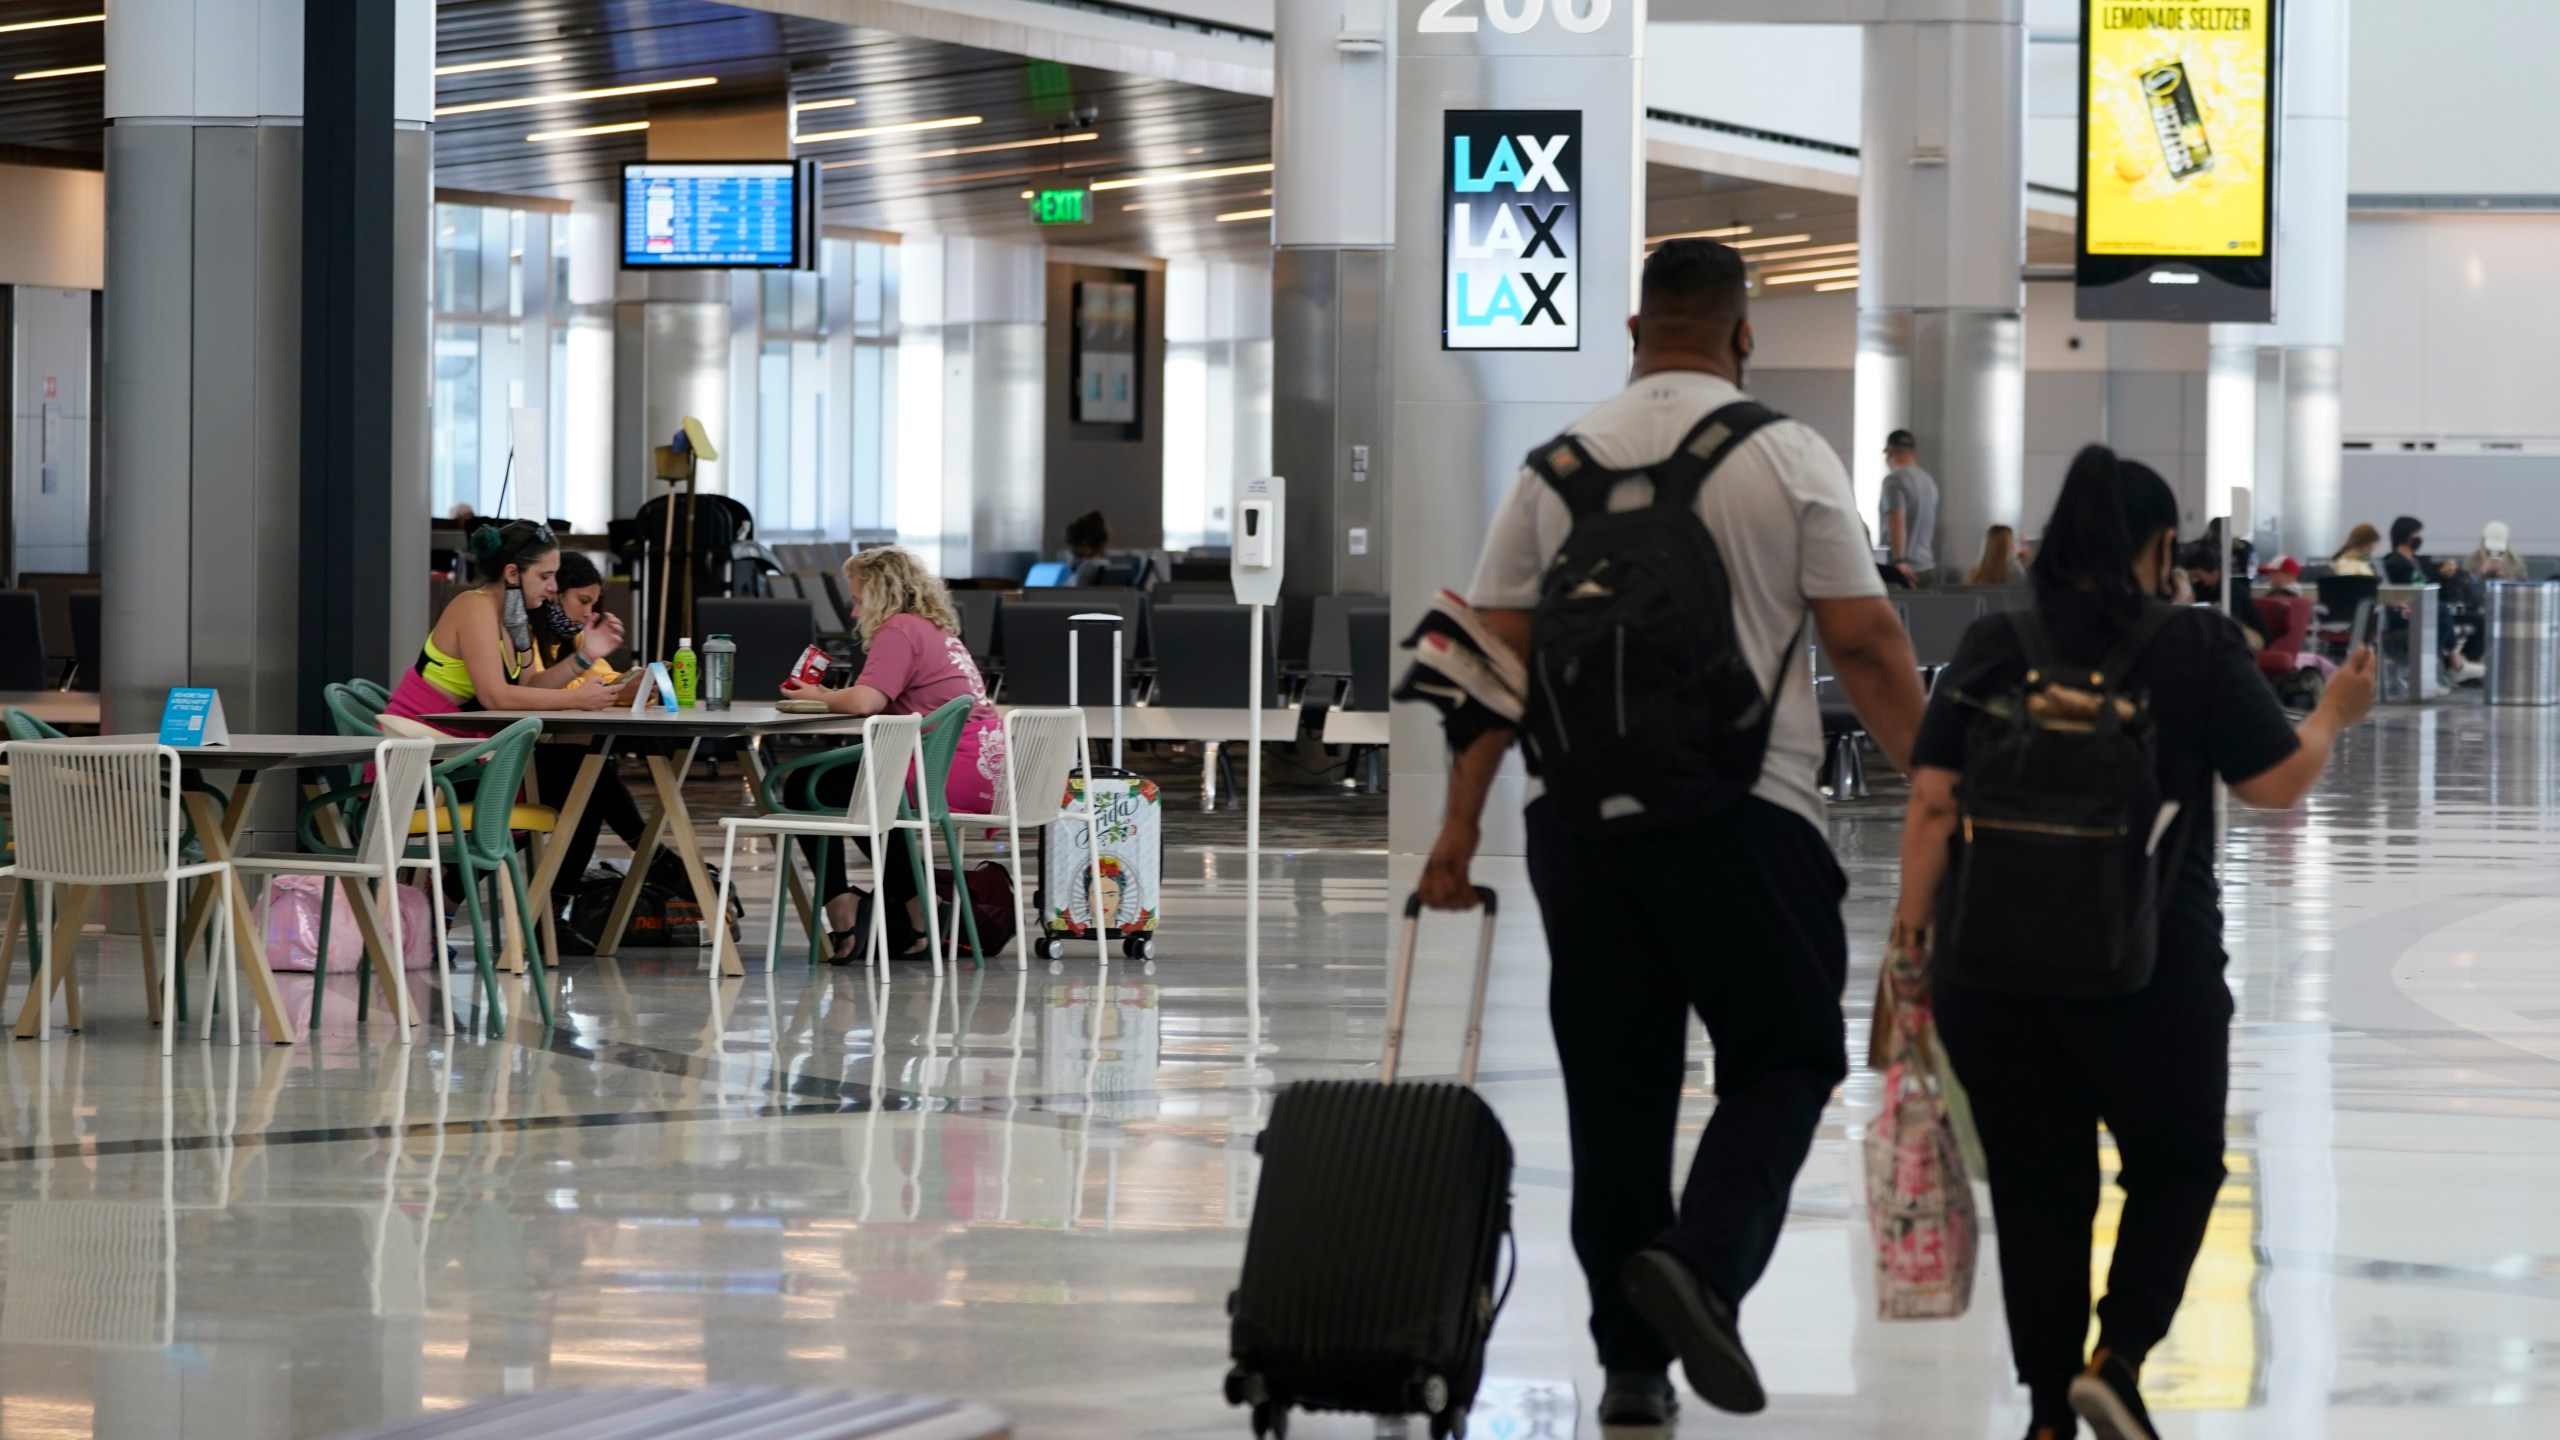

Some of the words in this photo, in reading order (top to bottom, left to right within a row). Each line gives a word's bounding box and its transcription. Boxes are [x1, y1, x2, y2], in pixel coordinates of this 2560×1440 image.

[2103, 7, 2185, 30] LEMONADE
[2189, 8, 2252, 31] SELTZER
[1454, 135, 1570, 192] LAX
[1041, 190, 1085, 222] EXIT
[1454, 203, 1570, 259] LAX
[1456, 272, 1567, 326] LAX
